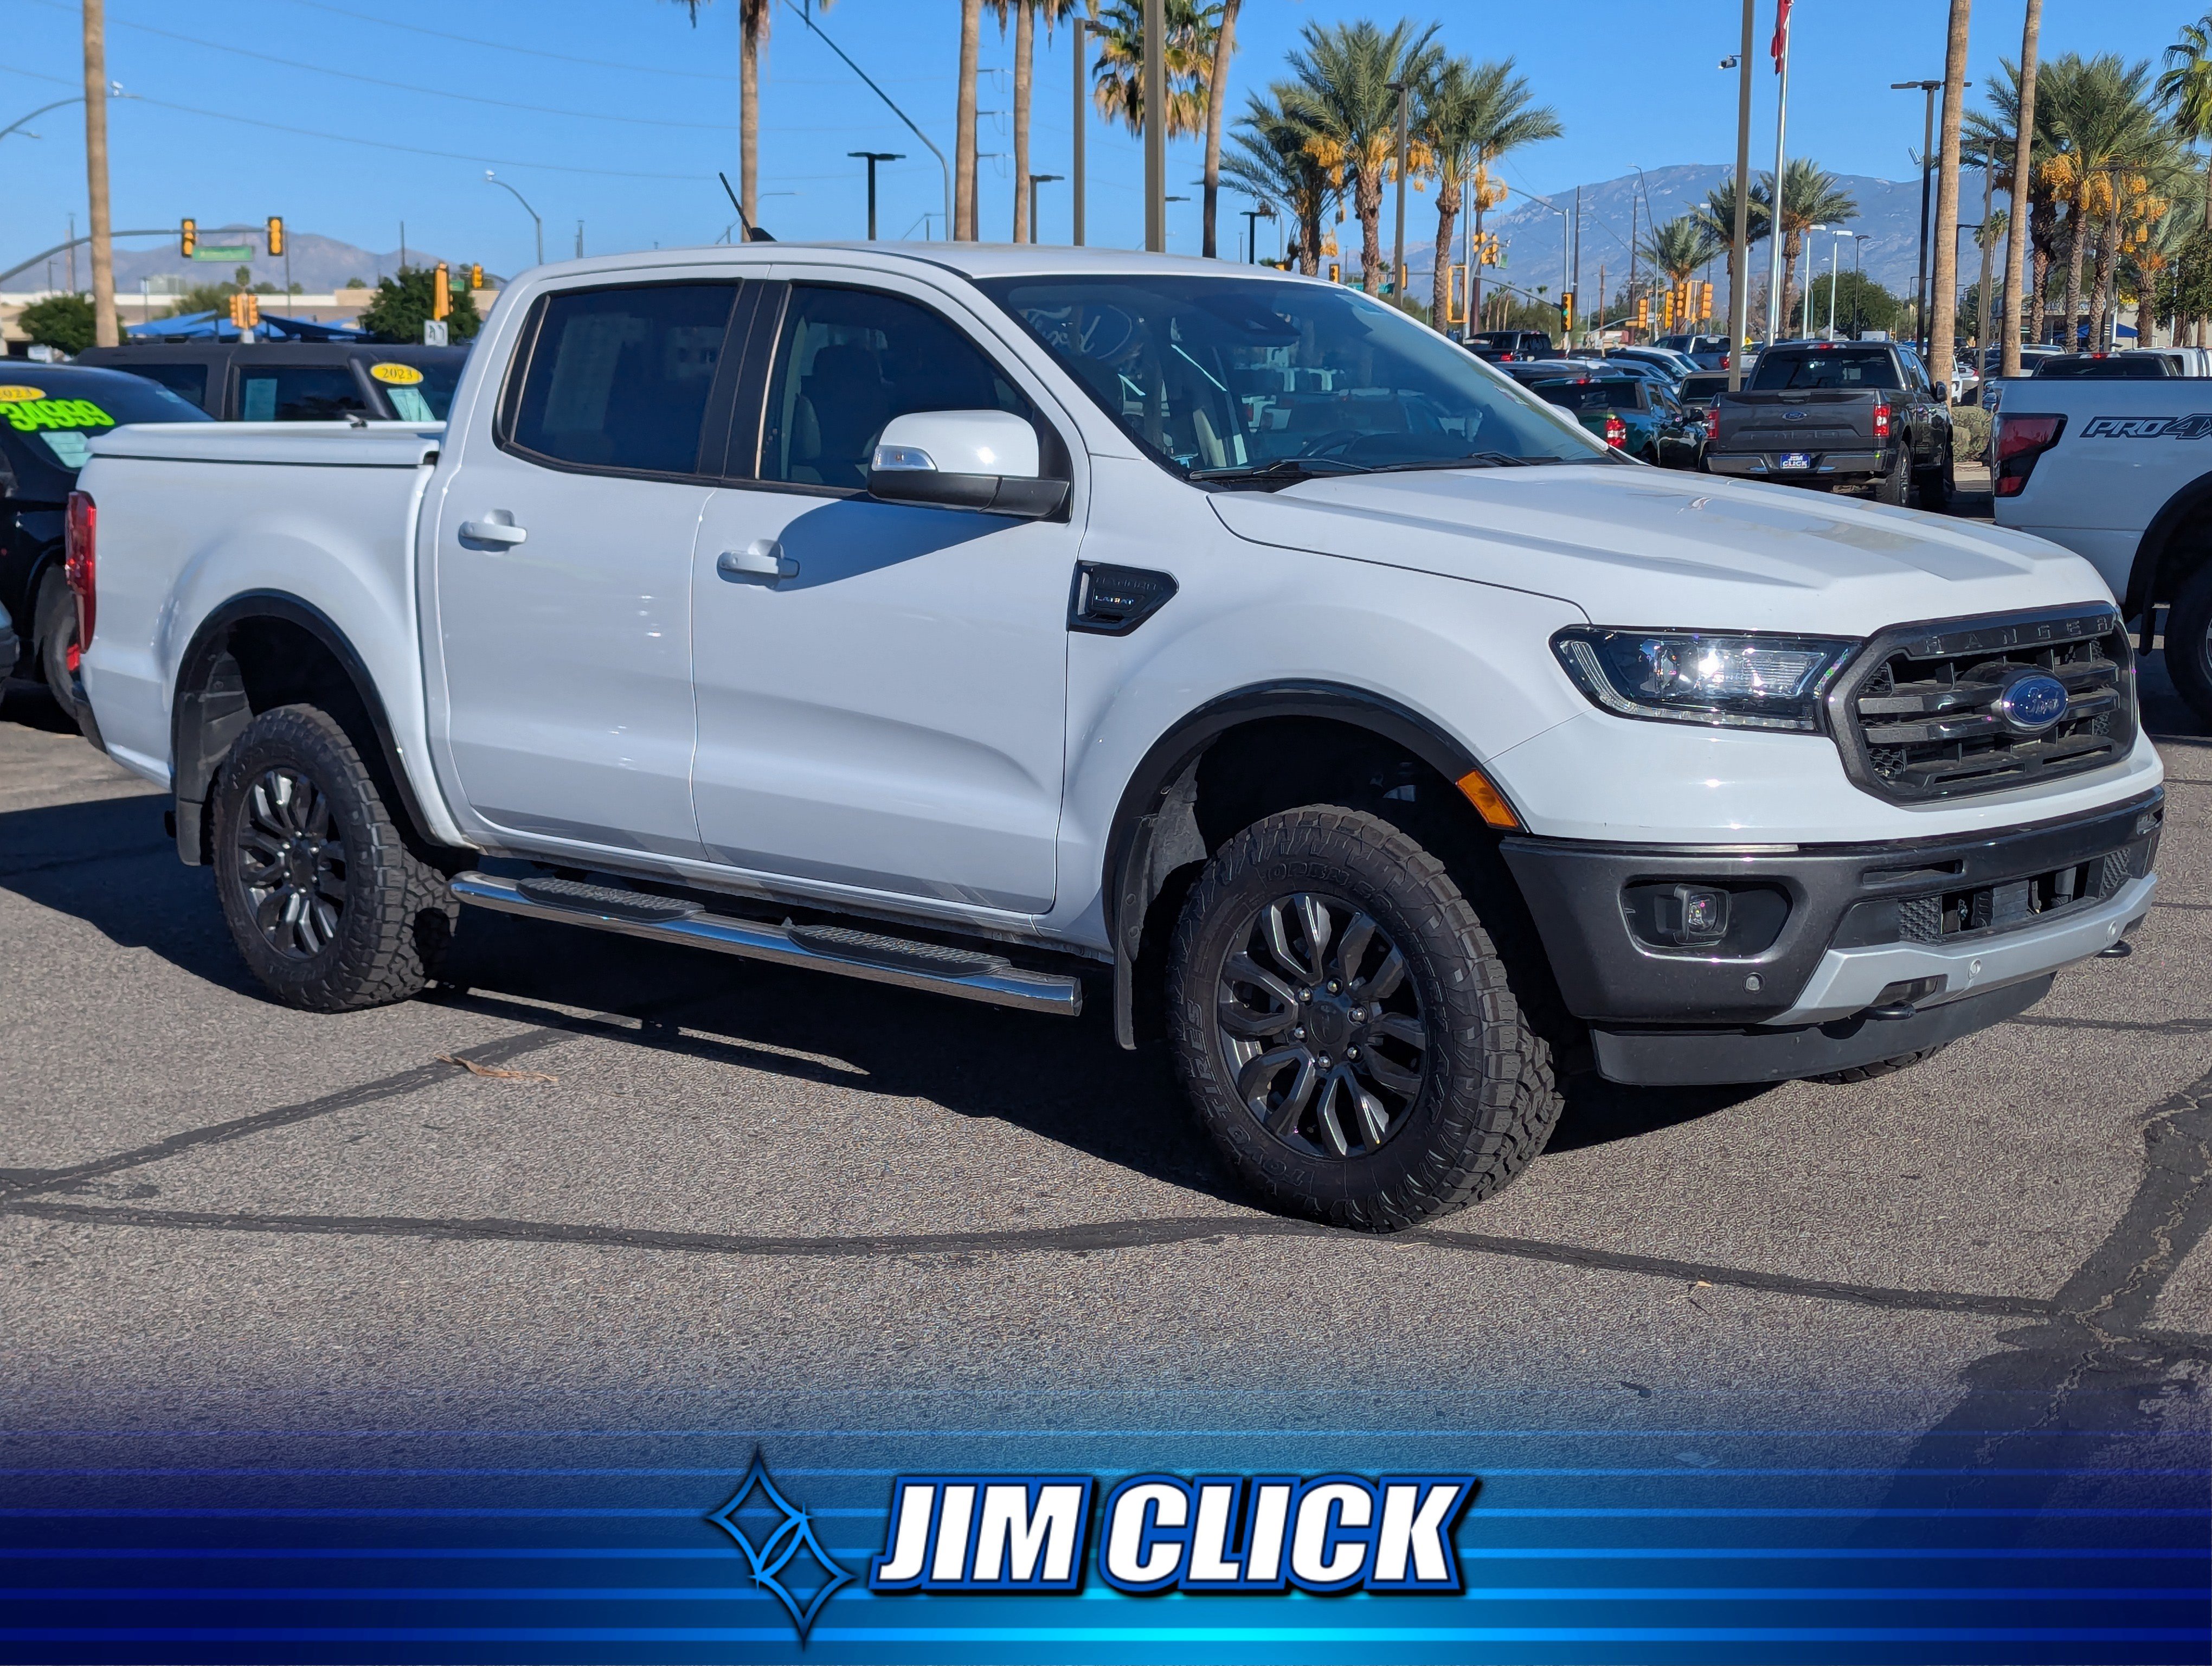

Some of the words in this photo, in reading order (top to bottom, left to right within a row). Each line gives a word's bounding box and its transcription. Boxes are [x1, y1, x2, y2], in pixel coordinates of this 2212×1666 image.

[382, 368, 413, 379] 2023
[0, 388, 33, 399] 023
[0, 399, 115, 431] 34999
[1925, 616, 2108, 654] RANGER
